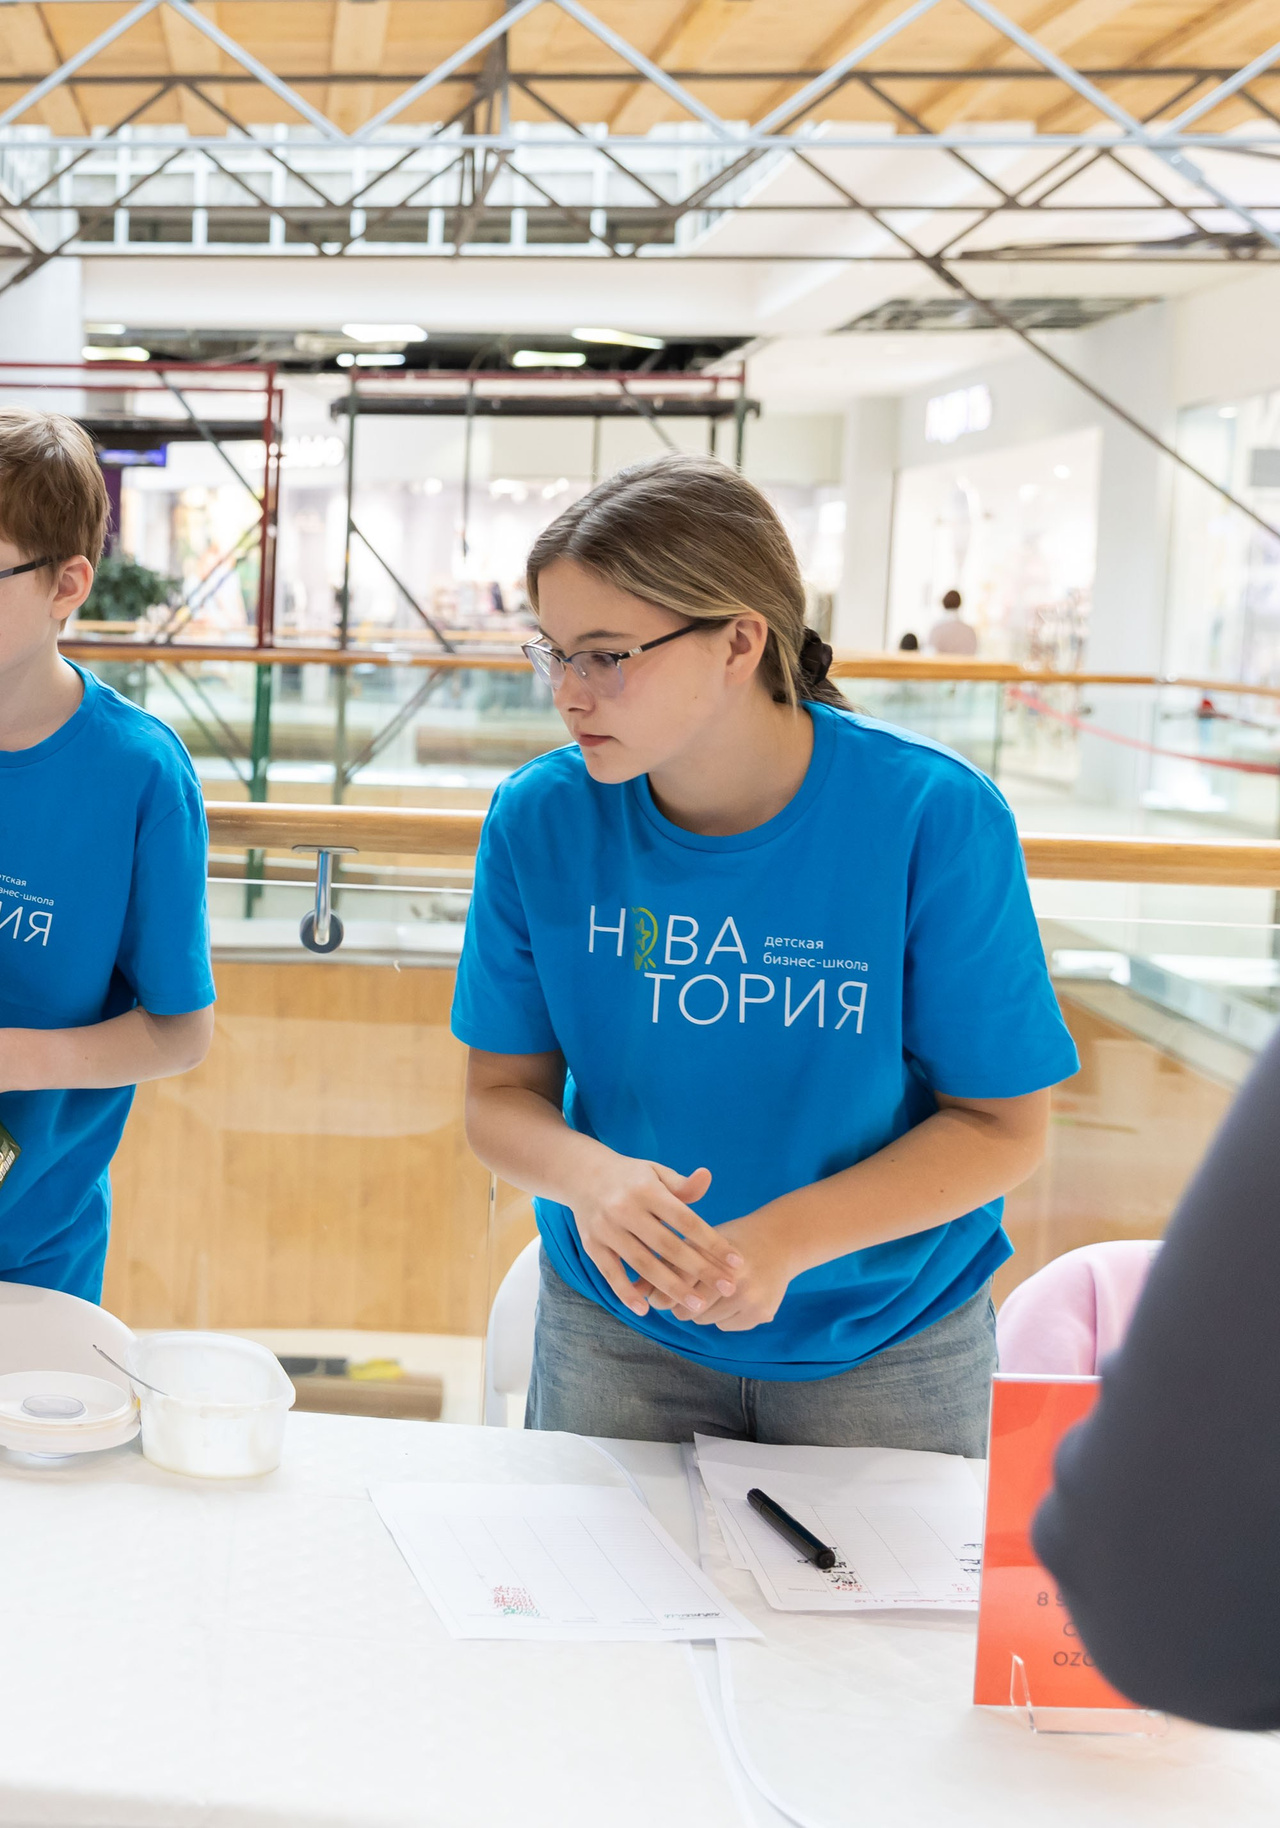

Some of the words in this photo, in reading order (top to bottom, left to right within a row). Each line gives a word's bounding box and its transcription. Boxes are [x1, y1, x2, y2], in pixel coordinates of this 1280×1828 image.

[764, 935, 824, 951] детская
[762, 952, 869, 972] бизнес-школа
[643, 971, 869, 1034] ТОРИЯ
